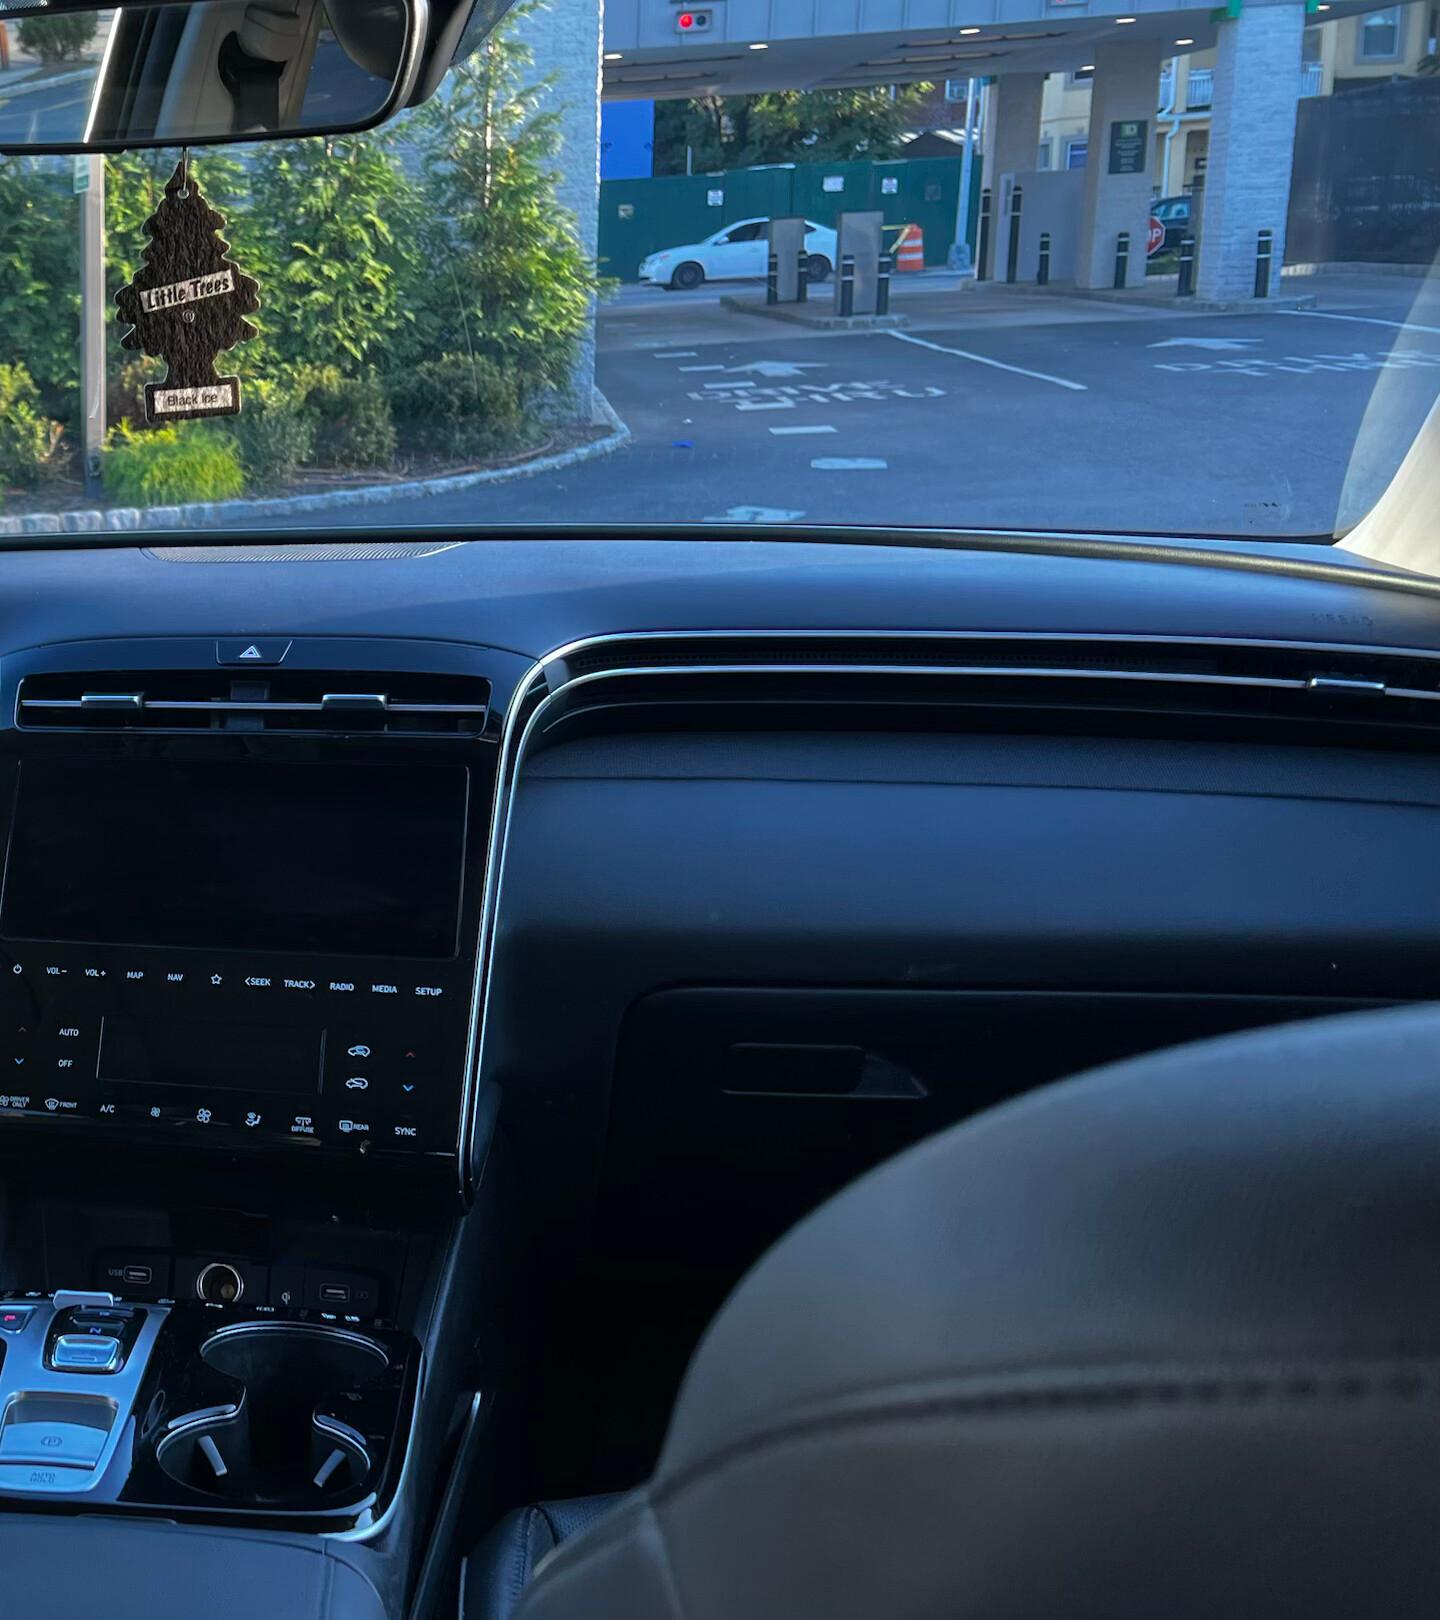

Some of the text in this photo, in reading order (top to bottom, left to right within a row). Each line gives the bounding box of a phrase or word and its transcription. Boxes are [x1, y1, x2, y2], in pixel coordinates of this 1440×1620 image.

[146, 277, 230, 309] Little Trees
[166, 392, 218, 407] Black Ice
[126, 971, 144, 979] MAP
[167, 973, 184, 982] NAV
[329, 982, 355, 992] RADIO
[371, 984, 398, 994] MEDIA
[415, 986, 442, 996] SETUP
[59, 1028, 80, 1037] AUTO
[58, 1059, 73, 1068] OFF
[100, 1104, 115, 1113] A/C
[394, 1126, 417, 1136] SYNC
[108, 1268, 123, 1277] USB
